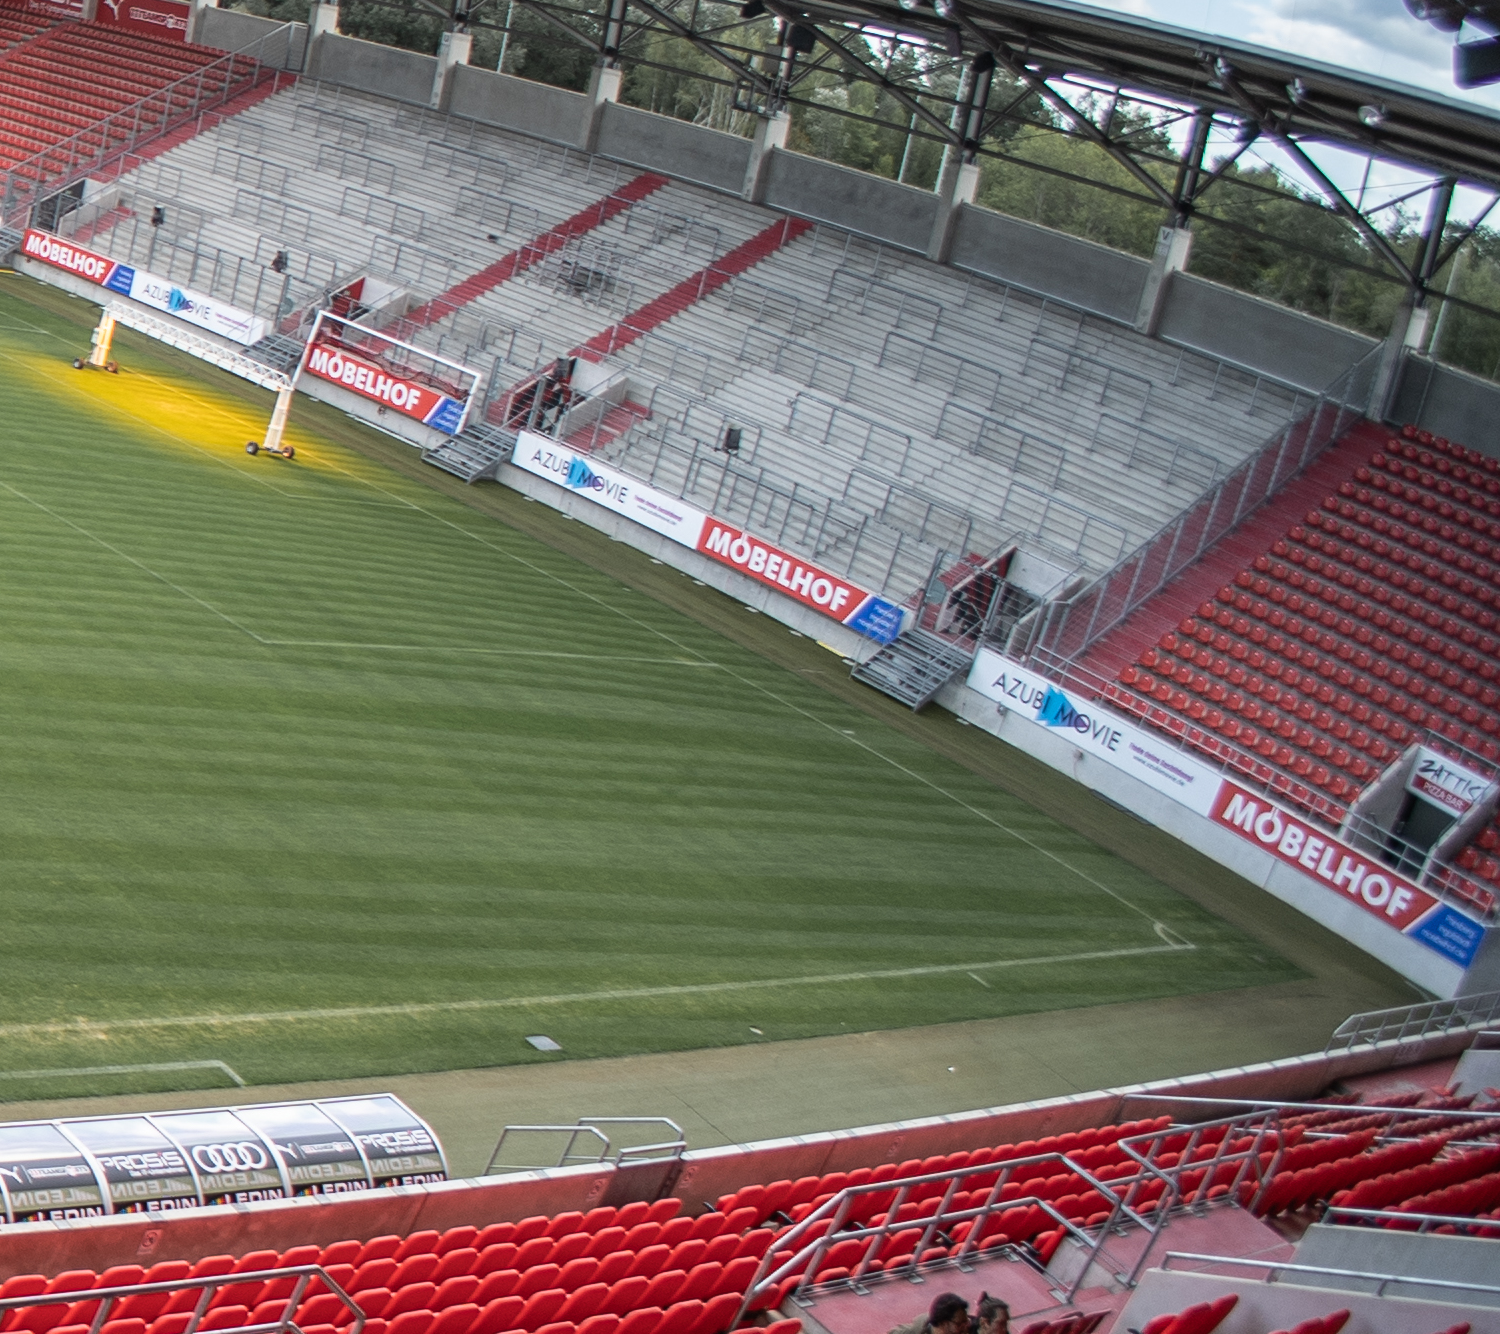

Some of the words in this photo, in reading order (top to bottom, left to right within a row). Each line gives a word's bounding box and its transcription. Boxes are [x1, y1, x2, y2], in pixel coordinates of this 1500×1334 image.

[25, 234, 106, 279] MÖBELHOF
[309, 348, 421, 411] MÖBELHOF
[531, 449, 575, 478] AZUBI
[577, 473, 629, 504] MOVIE
[705, 526, 850, 612] MÖBELHOF
[992, 672, 1051, 715] AZUBI
[1054, 703, 1122, 753] MOVIE
[1222, 793, 1413, 918] MÖBELHOF
